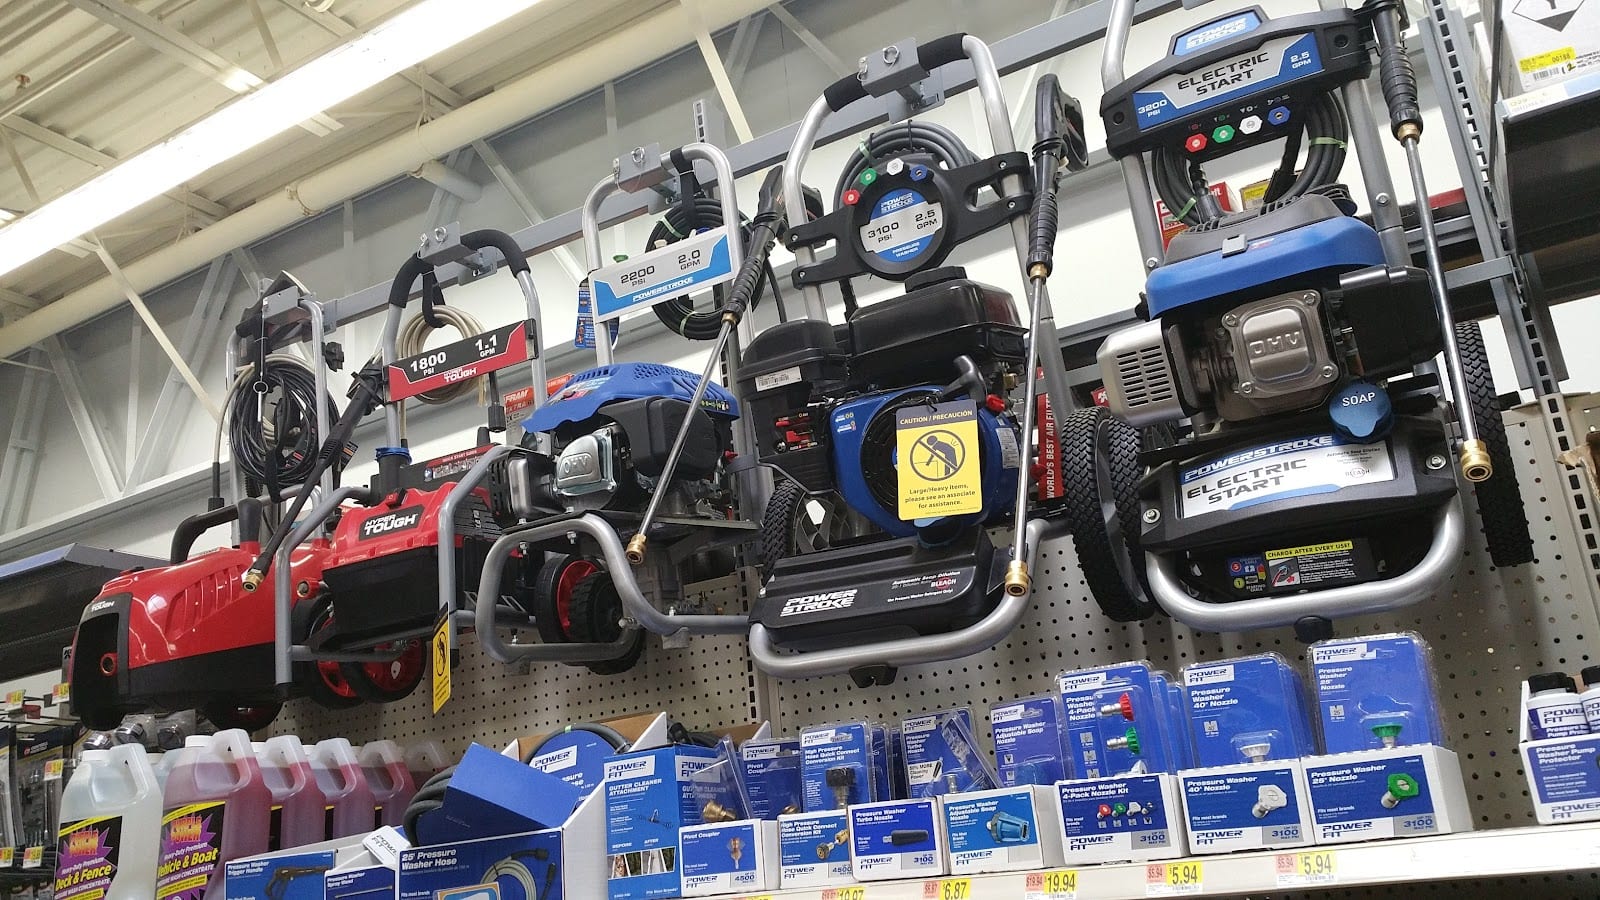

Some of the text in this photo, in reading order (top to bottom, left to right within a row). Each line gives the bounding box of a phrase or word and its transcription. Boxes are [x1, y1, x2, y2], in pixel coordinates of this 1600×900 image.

[1290, 52, 1309, 62] 2.5
[1292, 59, 1311, 69] GPM
[1178, 53, 1269, 90] ELECTRIC
[1197, 69, 1254, 95] START
[1138, 100, 1167, 114] 3200
[1148, 109, 1161, 117] PSI
[915, 210, 935, 222] 2.5
[868, 222, 899, 238] 3100
[917, 219, 938, 230] GPM
[878, 235, 892, 243] PSI
[621, 250, 700, 284] 2200 2.0
[680, 259, 701, 270] GPM
[633, 277, 694, 301] POWERSTROKE
[1250, 331, 1300, 354] OHV
[411, 335, 497, 372] 1800 1.1
[423, 348, 495, 376] PSI GPM
[444, 367, 477, 382] TOUGH
[505, 389, 528, 402] FRAM
[1342, 392, 1376, 407] SOAP
[900, 416, 928, 425] CAUTION
[932, 410, 972, 421] PRECAUCIÓN
[1046, 422, 1054, 436] AIR
[564, 455, 590, 474] OHV
[1184, 436, 1335, 481] POWERSTROKE
[1187, 459, 1307, 499] ELECTRIC
[910, 485, 948, 495] Large/Heavy
[1209, 476, 1284, 504] START
[905, 494, 925, 503] please
[926, 493, 936, 501] see
[947, 490, 976, 498] associate
[928, 500, 963, 508] assistance.
[364, 514, 418, 536] TOUGH
[365, 514, 396, 526] HYPER
[1315, 544, 1333, 552] EVERY
[931, 579, 956, 587] BLEACH
[786, 589, 857, 606] POWER
[780, 597, 855, 616] STROKE
[1189, 668, 1227, 677] POWER
[1191, 687, 1230, 696] Pressure
[1192, 694, 1224, 702] Washer
[1210, 699, 1238, 707] Nozzle
[1069, 713, 1095, 721] Nozzle
[995, 721, 1046, 734] Pressure Washer
[996, 731, 1027, 740] Adjustable
[1536, 744, 1576, 753] Pressure
[1537, 750, 1570, 759] Washer
[535, 750, 572, 766] POWER
[1539, 755, 1582, 765] Protector
[609, 761, 646, 772] POWER
[1311, 765, 1386, 778] Pressure Washer
[1187, 779, 1224, 787] Pressure
[1329, 774, 1358, 783] Nozzle
[609, 779, 662, 791] GUTTER CLEANER
[609, 786, 649, 796] ATTACHMENT
[1062, 786, 1096, 794] Pressure
[856, 810, 882, 818] Pressure
[949, 808, 980, 817] Adjustable
[1404, 819, 1433, 827] 3100
[781, 831, 811, 839] Conversion
[1197, 830, 1242, 838] POWER
[1272, 829, 1299, 837] 3100
[1071, 836, 1113, 844] POWER
[182, 855, 189, 868] &
[191, 848, 218, 866] Boat
[417, 849, 456, 859] Pressure
[228, 862, 250, 871] Pressure
[402, 860, 433, 870] Washer
[435, 857, 457, 866] Hose
[1301, 854, 1332, 875] $5.94
[56, 865, 111, 891] Deck & Fence
[228, 868, 245, 876] Trigger
[1170, 865, 1198, 884] $5.94
[1044, 874, 1076, 892] $19.94
[943, 882, 967, 900] $6.87
